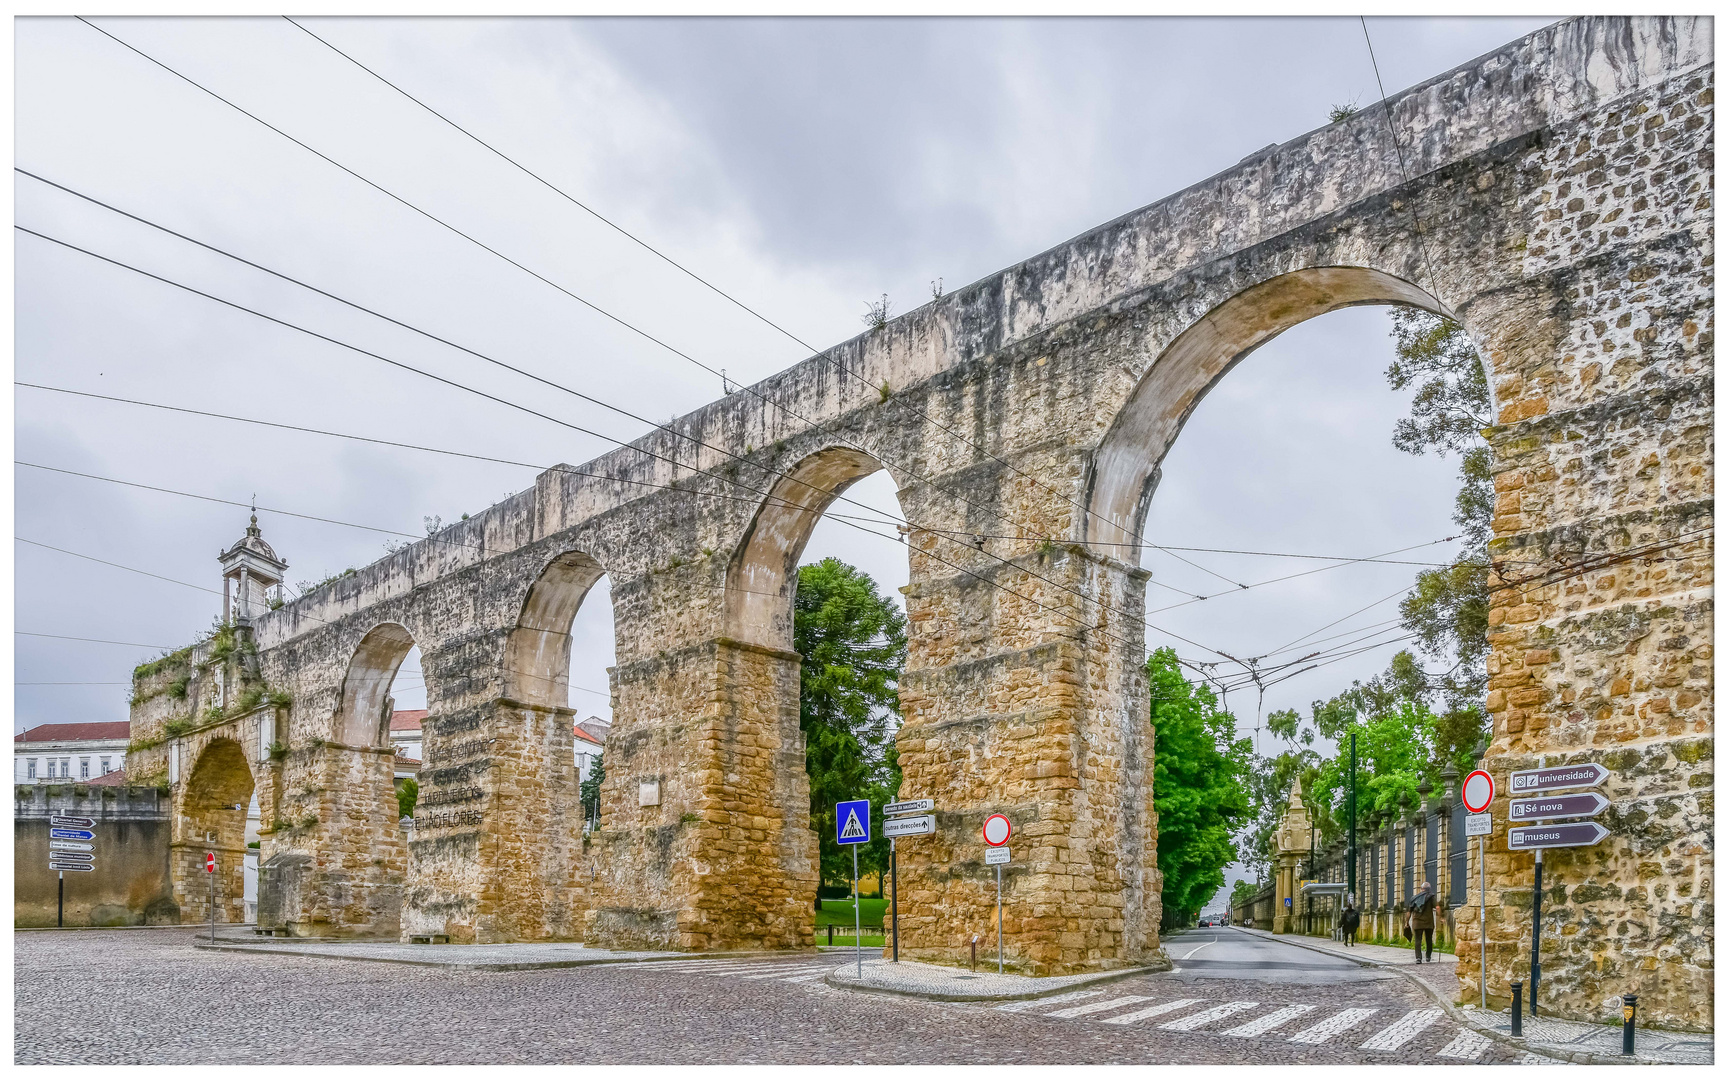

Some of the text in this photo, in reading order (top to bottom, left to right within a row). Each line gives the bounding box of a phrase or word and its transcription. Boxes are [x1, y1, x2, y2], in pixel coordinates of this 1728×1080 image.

[1539, 770, 1594, 783] universidade
[1525, 803, 1563, 813] Sé nova
[900, 821, 921, 830] direcções
[1524, 832, 1560, 841] museus
